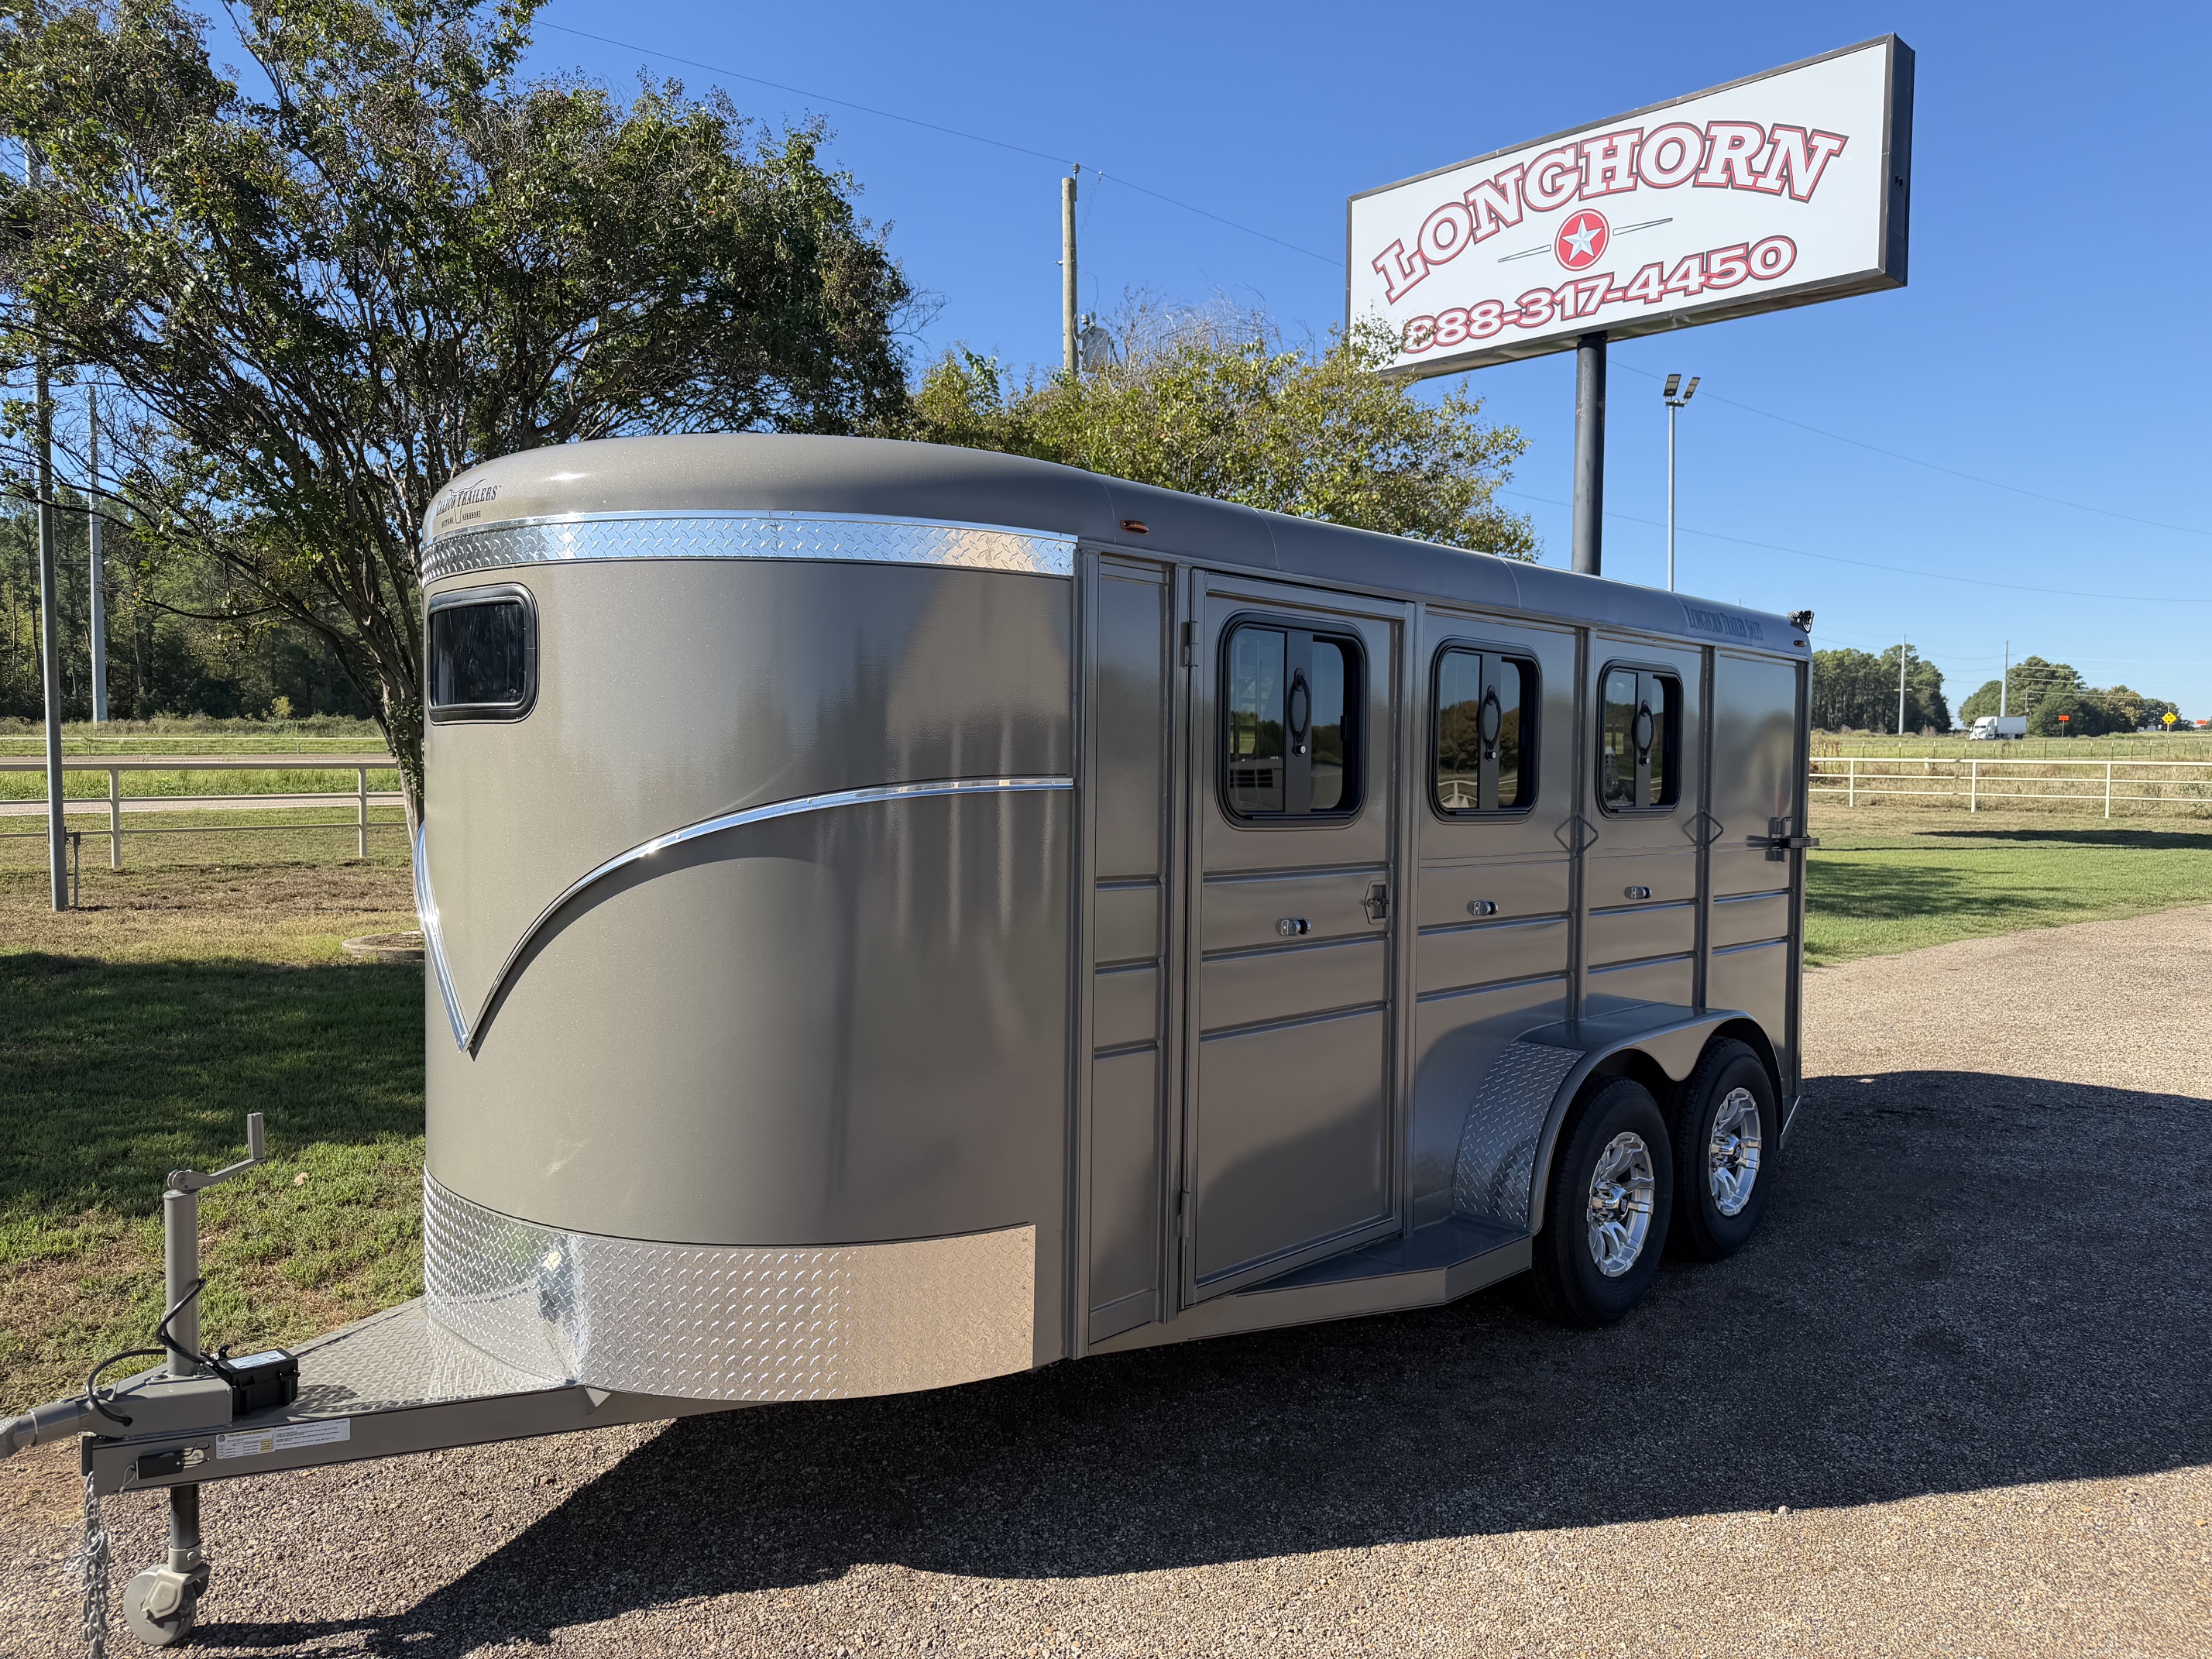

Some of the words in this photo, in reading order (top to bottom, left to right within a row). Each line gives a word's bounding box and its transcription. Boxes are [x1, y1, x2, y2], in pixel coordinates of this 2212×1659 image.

[1372, 120, 1849, 303] LONGHORN
[1402, 235, 1797, 354] 888-317-4450
[436, 496, 455, 517] CALICO
[456, 486, 497, 507] TRAILERS
[1684, 605, 1723, 634] LONGHORN
